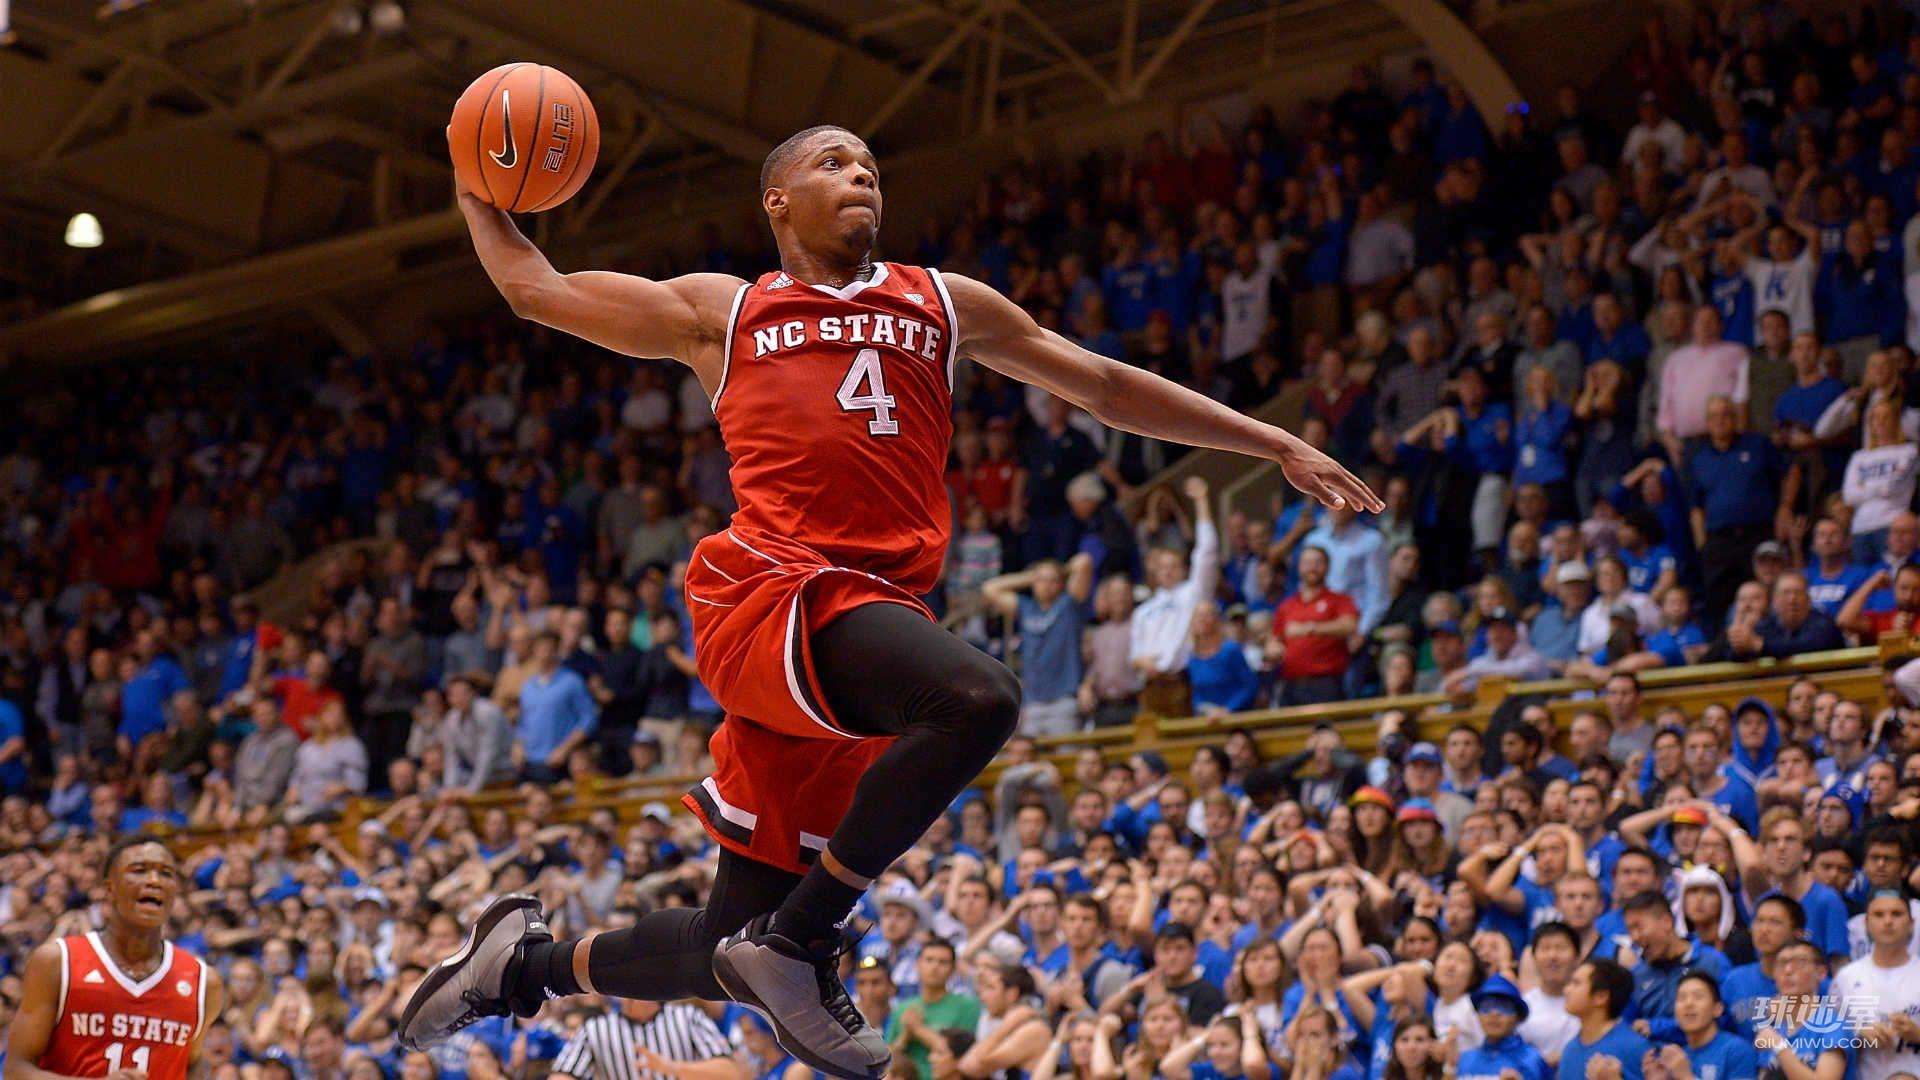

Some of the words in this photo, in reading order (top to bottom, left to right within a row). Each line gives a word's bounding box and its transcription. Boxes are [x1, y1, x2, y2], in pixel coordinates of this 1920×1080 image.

[542, 103, 571, 172] ELITE
[753, 320, 806, 359] NC
[819, 314, 941, 361] STATE
[836, 348, 898, 435] 4
[72, 1013, 105, 1036] NC
[112, 1013, 191, 1046] STATE
[105, 1042, 149, 1075] 11
